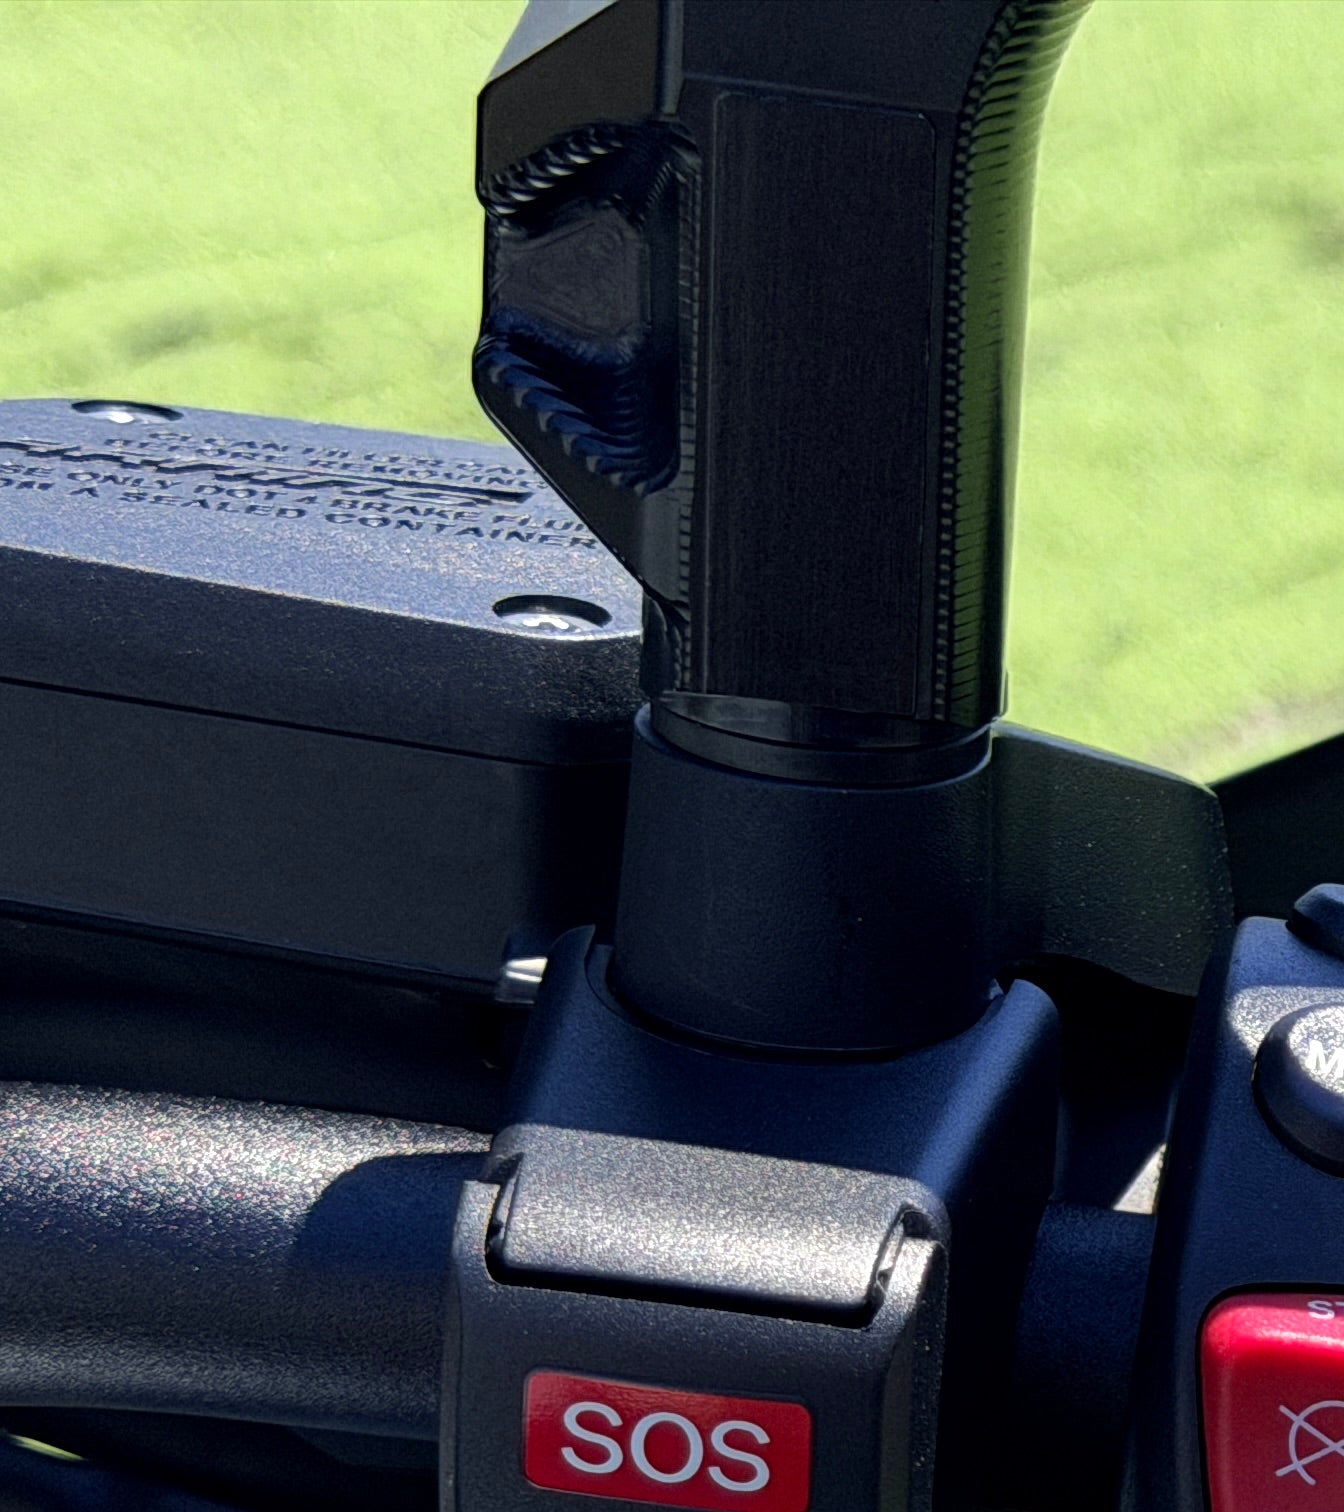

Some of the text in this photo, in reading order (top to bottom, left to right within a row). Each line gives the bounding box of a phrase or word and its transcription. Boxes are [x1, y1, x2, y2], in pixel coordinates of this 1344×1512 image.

[0, 464, 55, 478] SE
[66, 471, 183, 490] ONLY
[194, 484, 288, 500] DOT
[330, 498, 482, 522] BRAKE
[492, 515, 586, 533] FLUI
[68, 487, 100, 498] A
[118, 491, 306, 519] SEALED
[324, 513, 598, 550] CONTAINER
[560, 1401, 772, 1493] SOS
